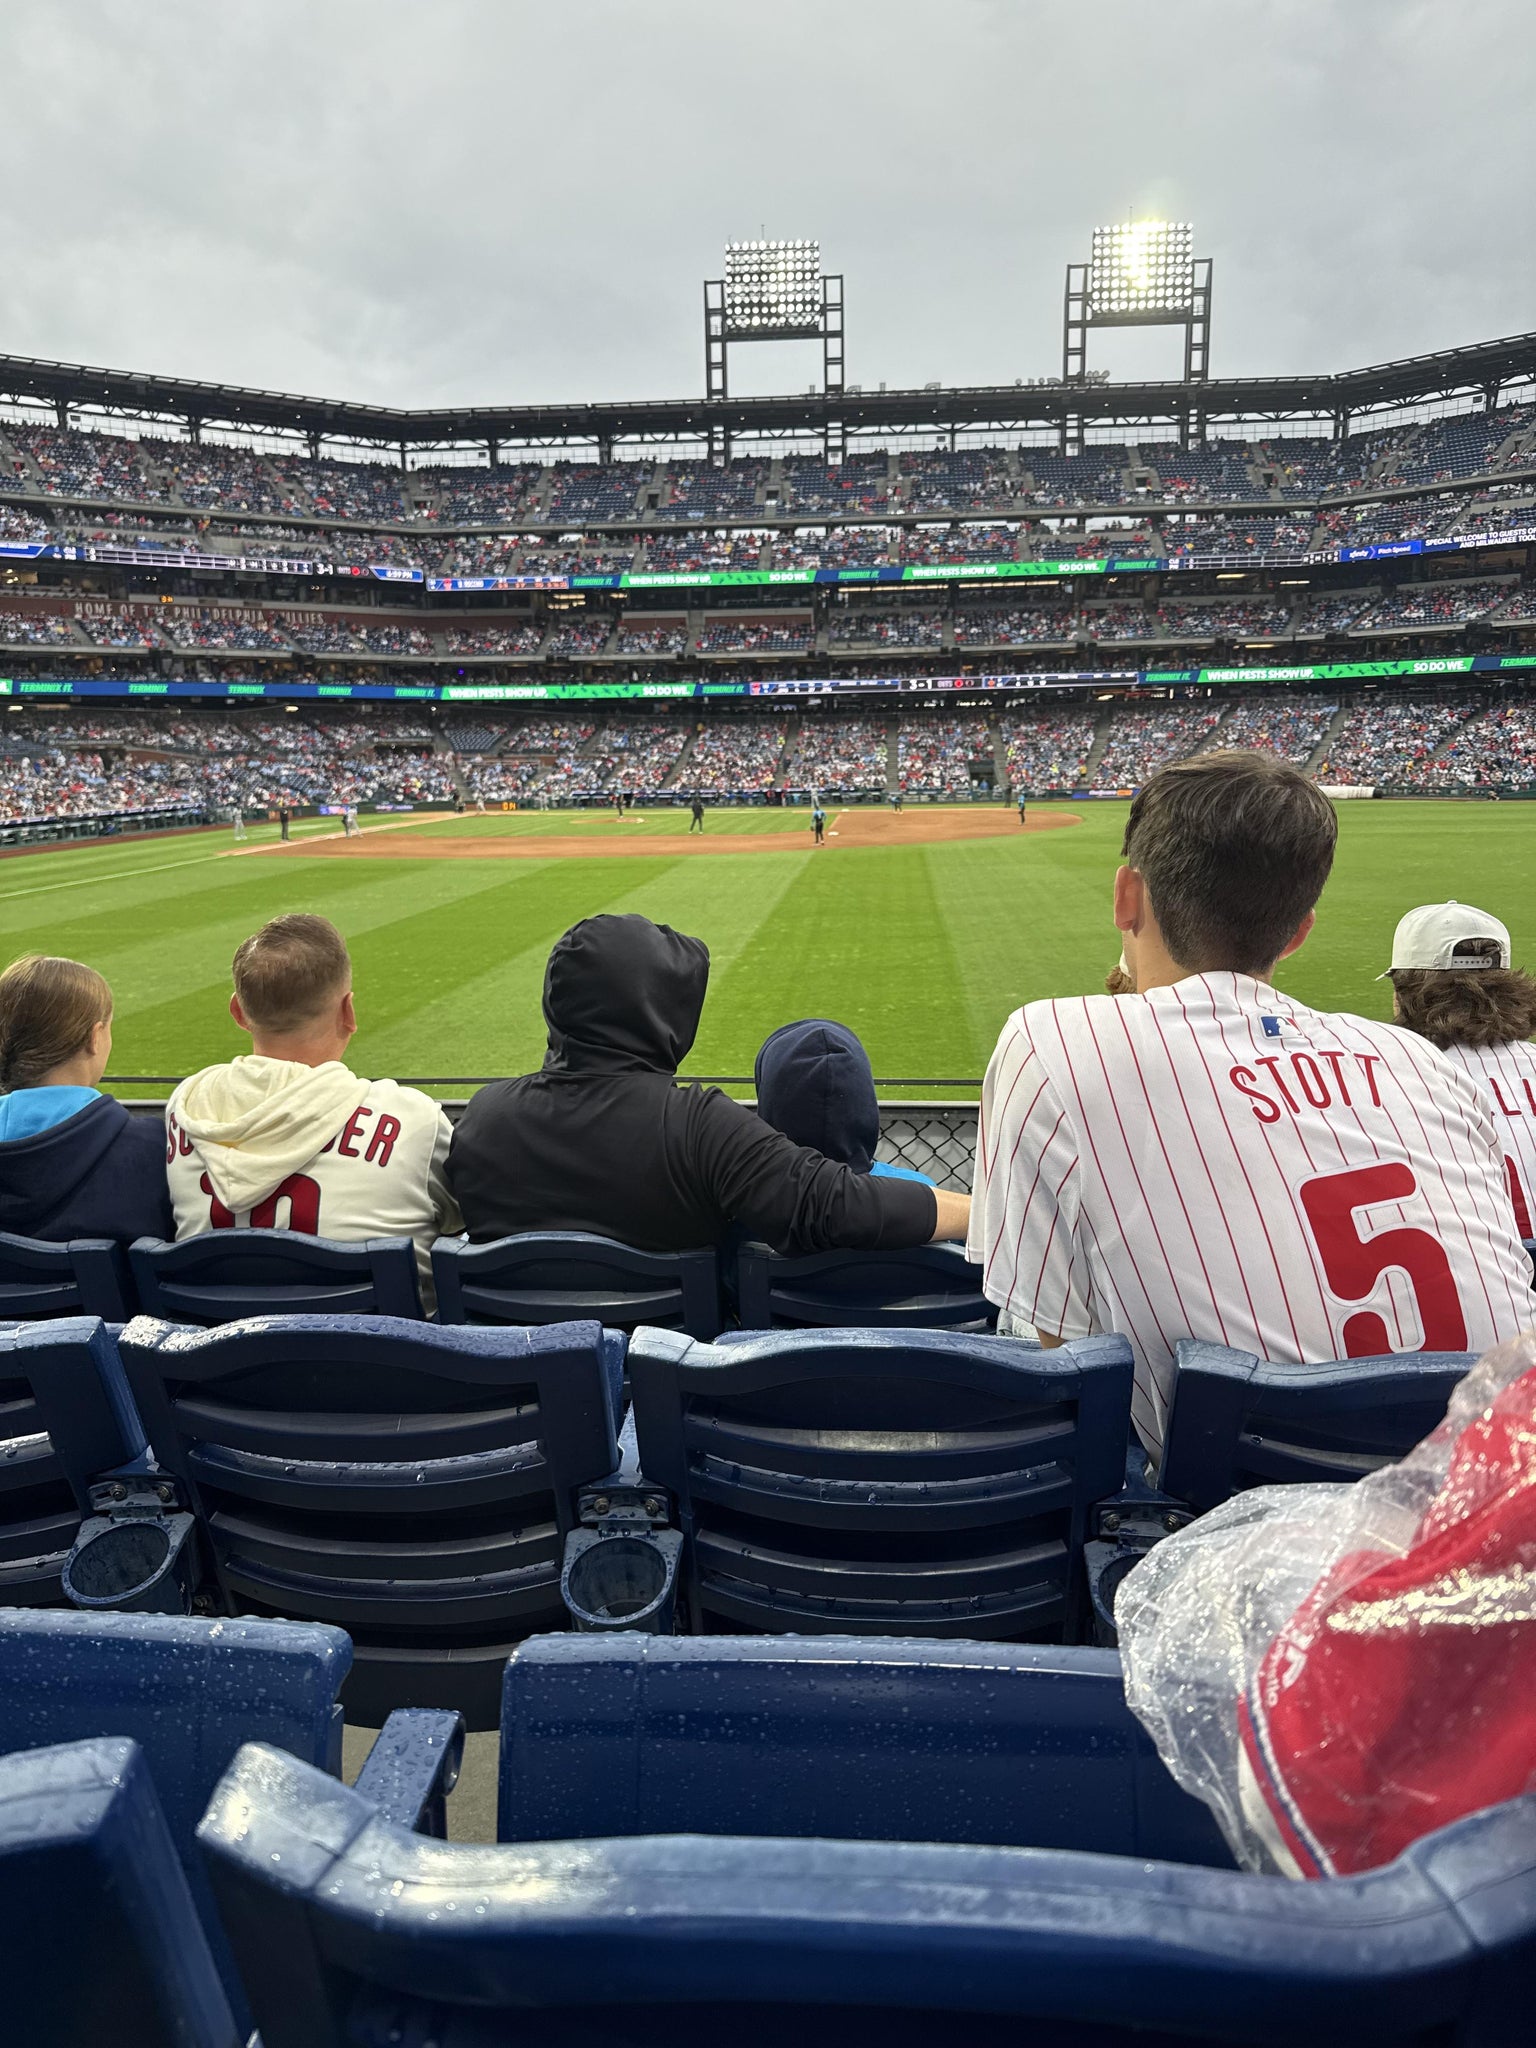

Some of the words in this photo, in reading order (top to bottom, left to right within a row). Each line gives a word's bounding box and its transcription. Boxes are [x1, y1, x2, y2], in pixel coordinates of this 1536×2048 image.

[1425, 537, 1453, 546] SPECIAL
[1453, 532, 1488, 543] WELCOME
[1488, 531, 1498, 539] TO
[1499, 528, 1527, 538] GUESTS
[1459, 541, 1475, 549] AND
[1476, 534, 1517, 547] MILWAUKEE
[912, 567, 937, 577] WHEN
[960, 567, 986, 576] SHOW
[1058, 564, 1071, 572] SO
[1071, 563, 1084, 571] DO
[74, 602, 112, 616] HOME
[120, 604, 136, 616] OF
[1413, 662, 1428, 672] SO
[1429, 662, 1446, 671] DO
[1447, 660, 1467, 671] WE.
[1207, 670, 1238, 681] WHEN
[1239, 670, 1267, 680] PESTS
[1267, 669, 1300, 679] SHOW
[1300, 668, 1314, 679] UP,
[909, 679, 933, 690] 3-1
[449, 687, 478, 698] WHEN
[478, 687, 505, 698] PESTS
[505, 687, 534, 698] SHOW
[642, 686, 657, 696] SO
[657, 686, 671, 695] DO
[1229, 1050, 1381, 1124] STOTT
[1299, 1161, 1468, 1359] 5
